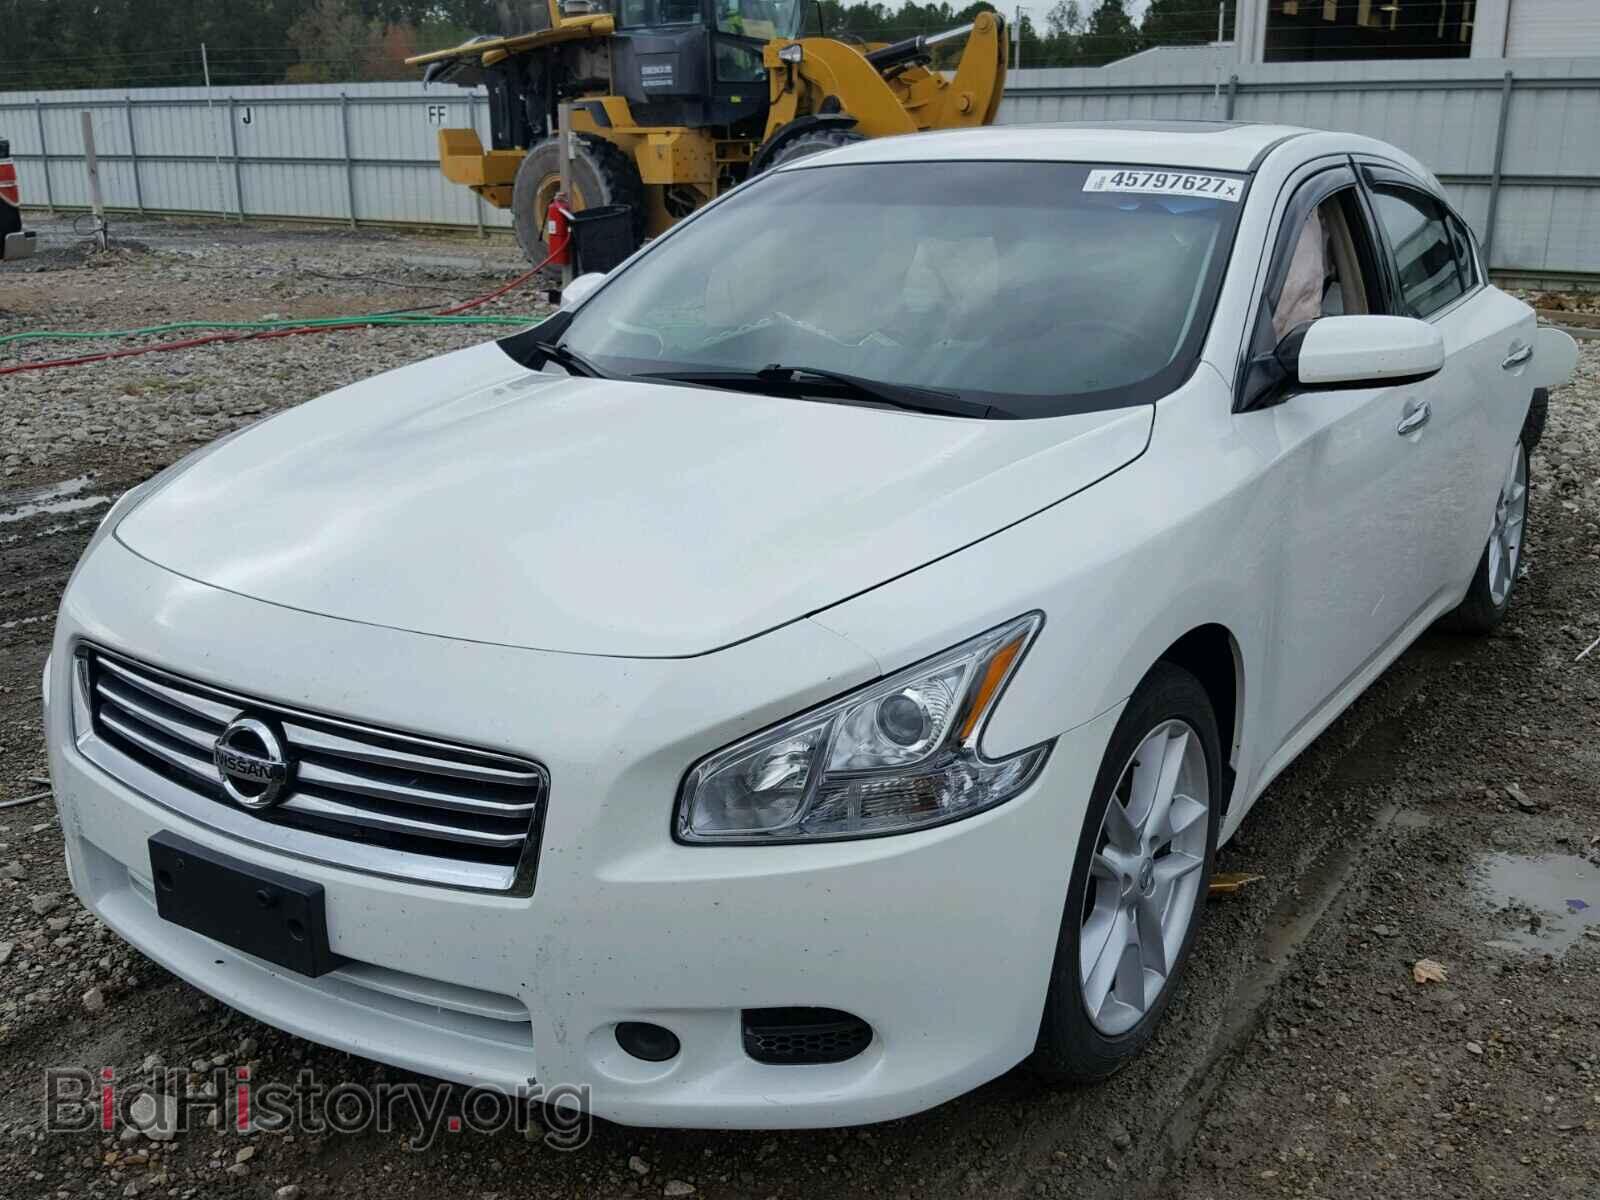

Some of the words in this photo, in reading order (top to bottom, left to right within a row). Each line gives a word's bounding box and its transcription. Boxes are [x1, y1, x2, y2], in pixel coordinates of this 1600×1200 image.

[242, 107, 252, 125] J
[428, 105, 446, 126] FF
[214, 750, 272, 779] NISSAN
